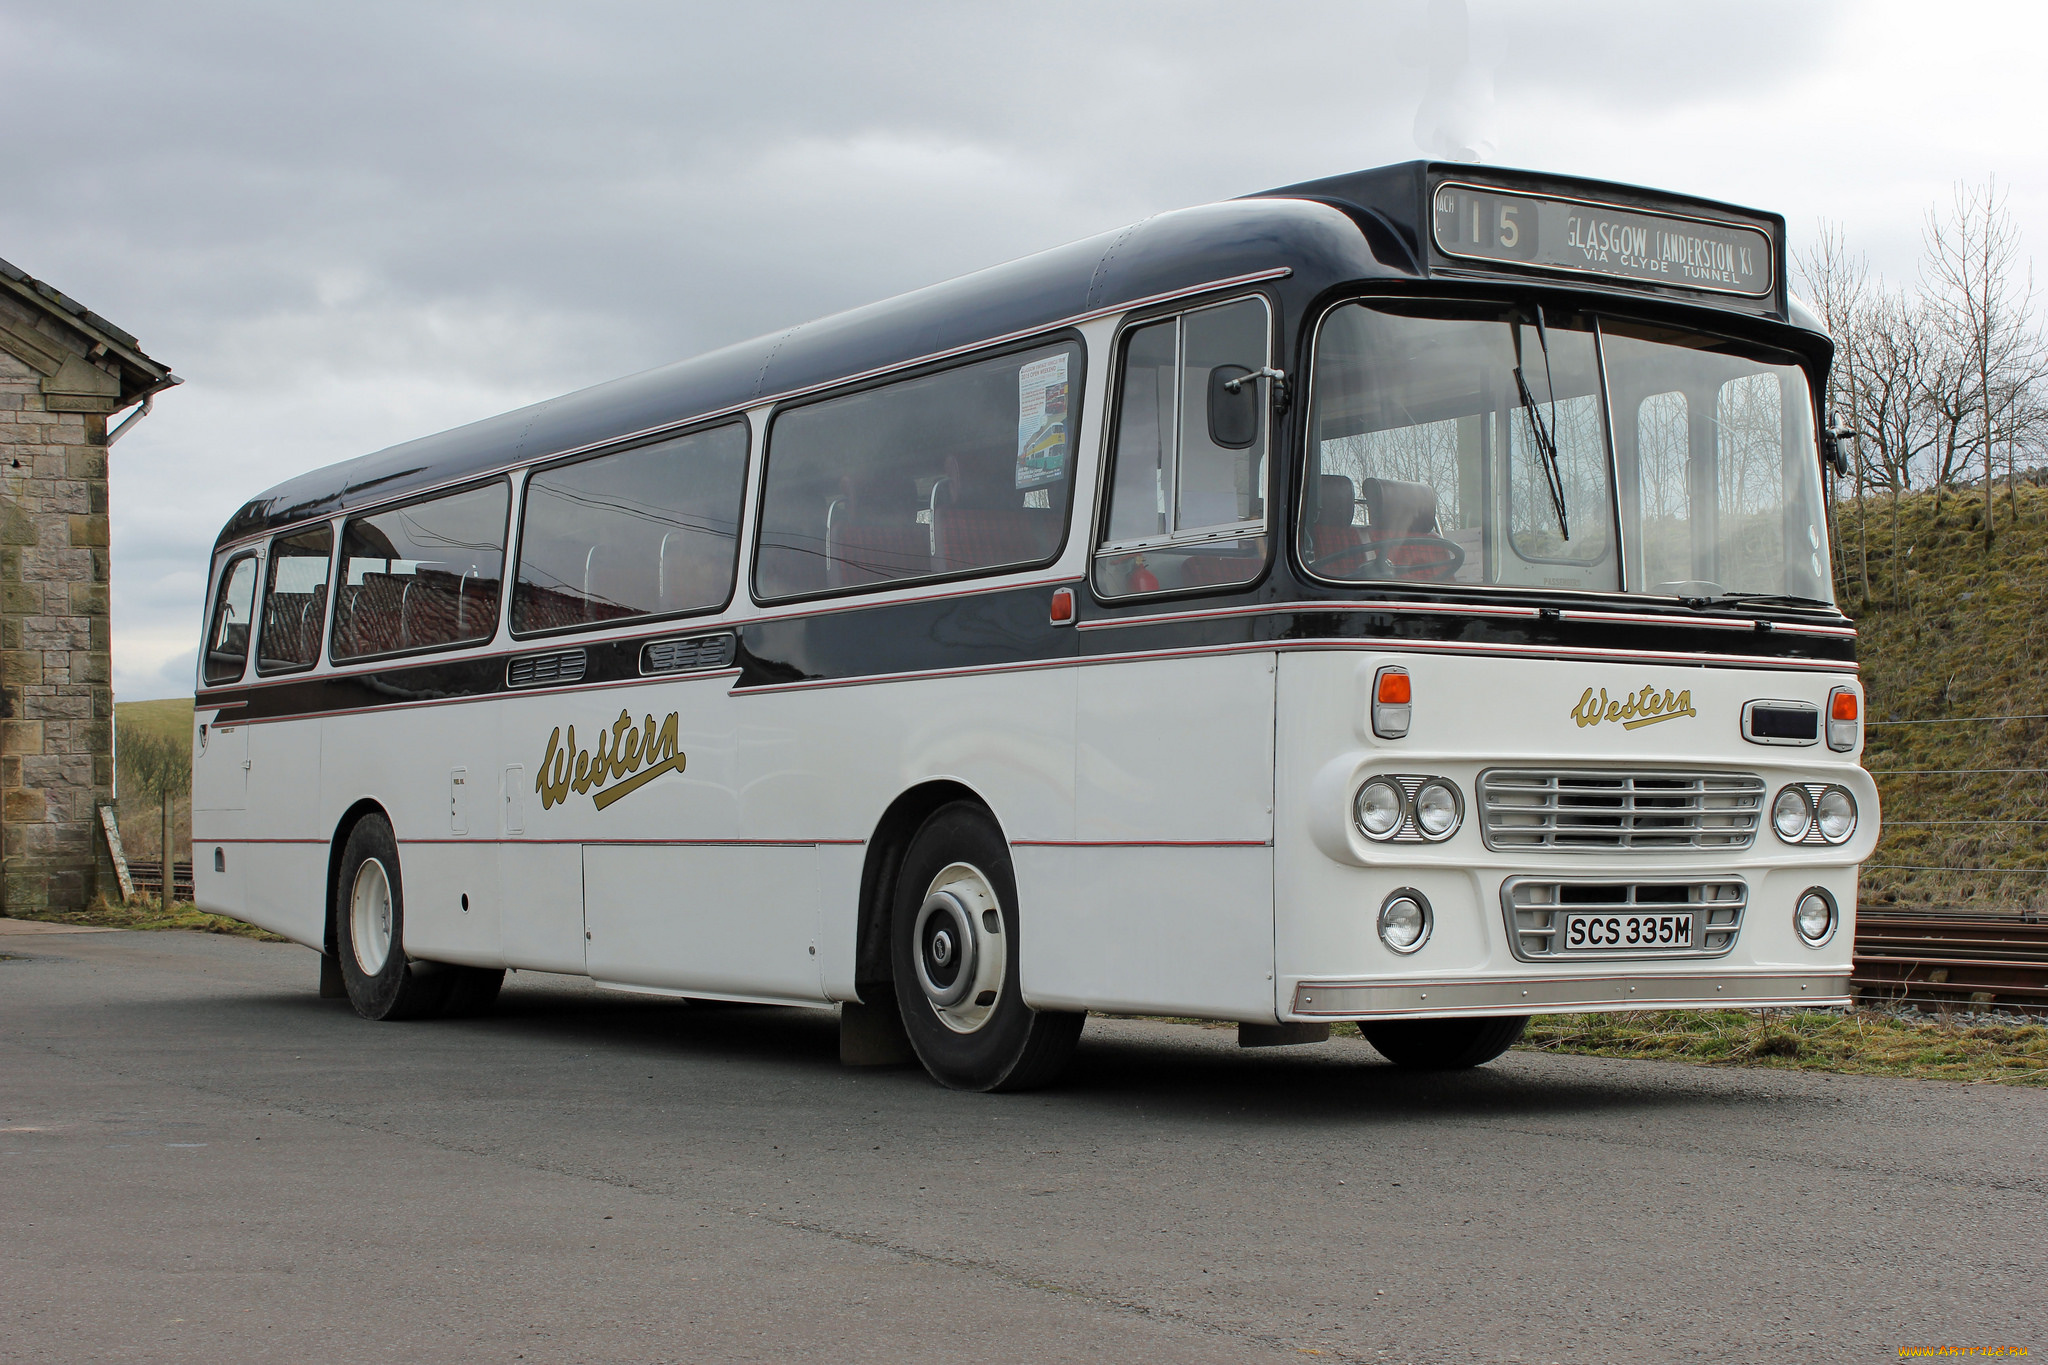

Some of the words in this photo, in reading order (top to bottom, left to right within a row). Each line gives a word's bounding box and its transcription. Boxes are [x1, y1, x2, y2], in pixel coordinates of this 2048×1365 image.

[1567, 216, 1647, 258] GLASGOW
[1583, 248, 1609, 263] VIA
[1620, 254, 1669, 274] CLYDE
[1683, 265, 1740, 284] TUNNEL
[1571, 684, 1697, 731] Western
[535, 708, 687, 812] Western
[1570, 918, 1620, 945] SCS
[1626, 916, 1690, 944] 335M
